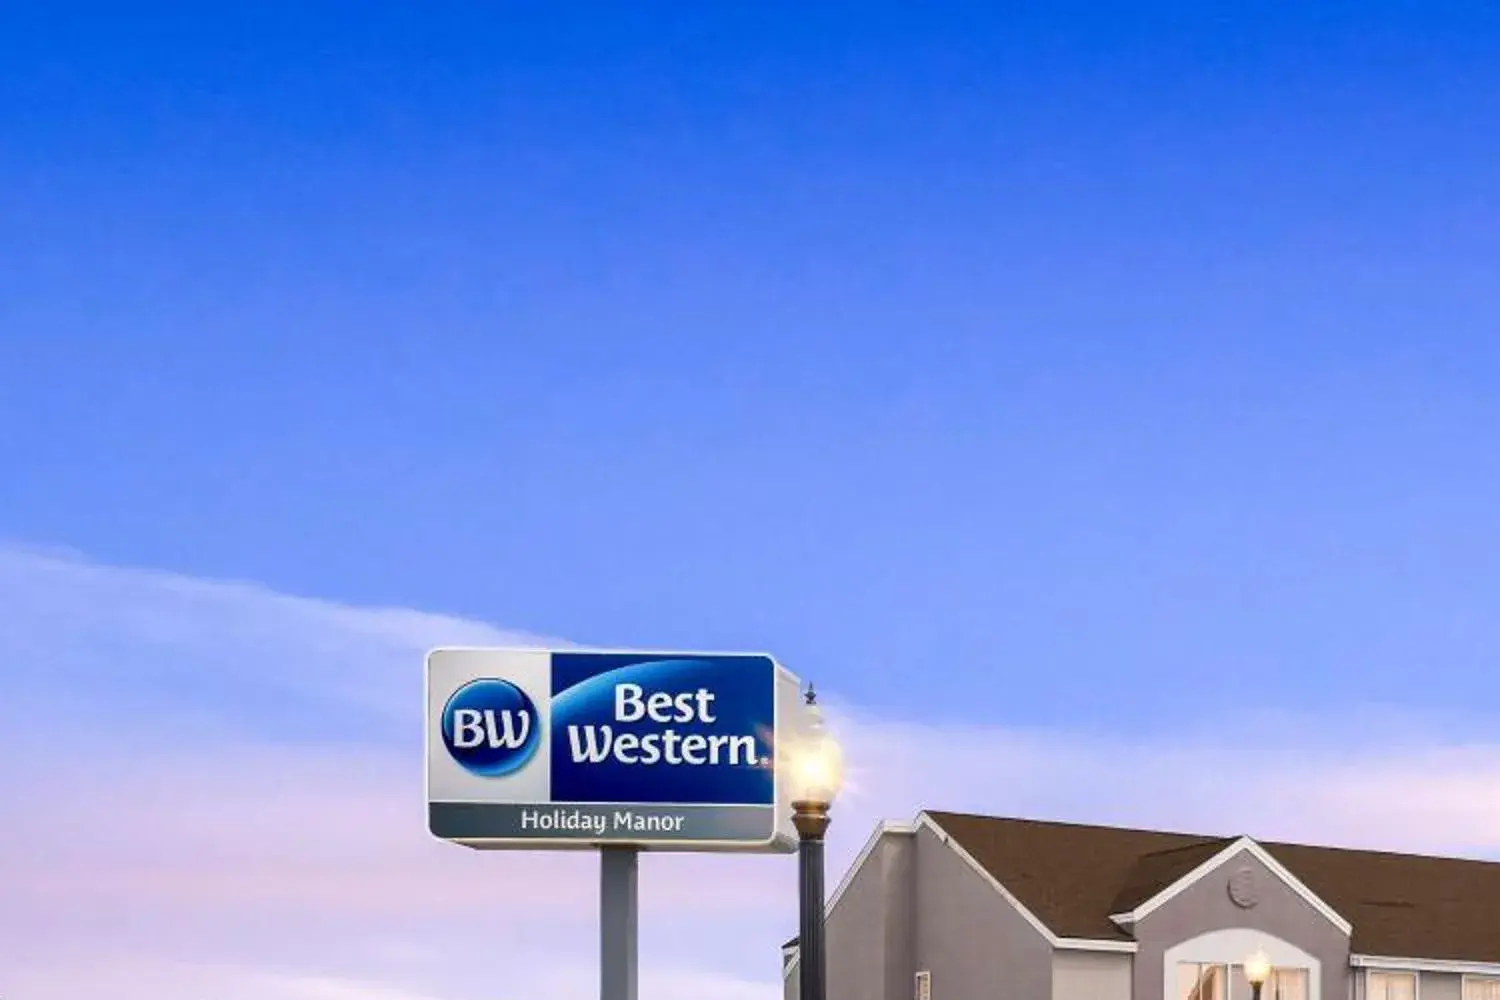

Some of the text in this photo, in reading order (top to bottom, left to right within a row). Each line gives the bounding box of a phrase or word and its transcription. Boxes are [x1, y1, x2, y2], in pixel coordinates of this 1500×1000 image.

[614, 682, 717, 723] Best
[453, 709, 530, 749] BW
[567, 724, 758, 765] Western
[521, 809, 685, 834] Holiday Manor
